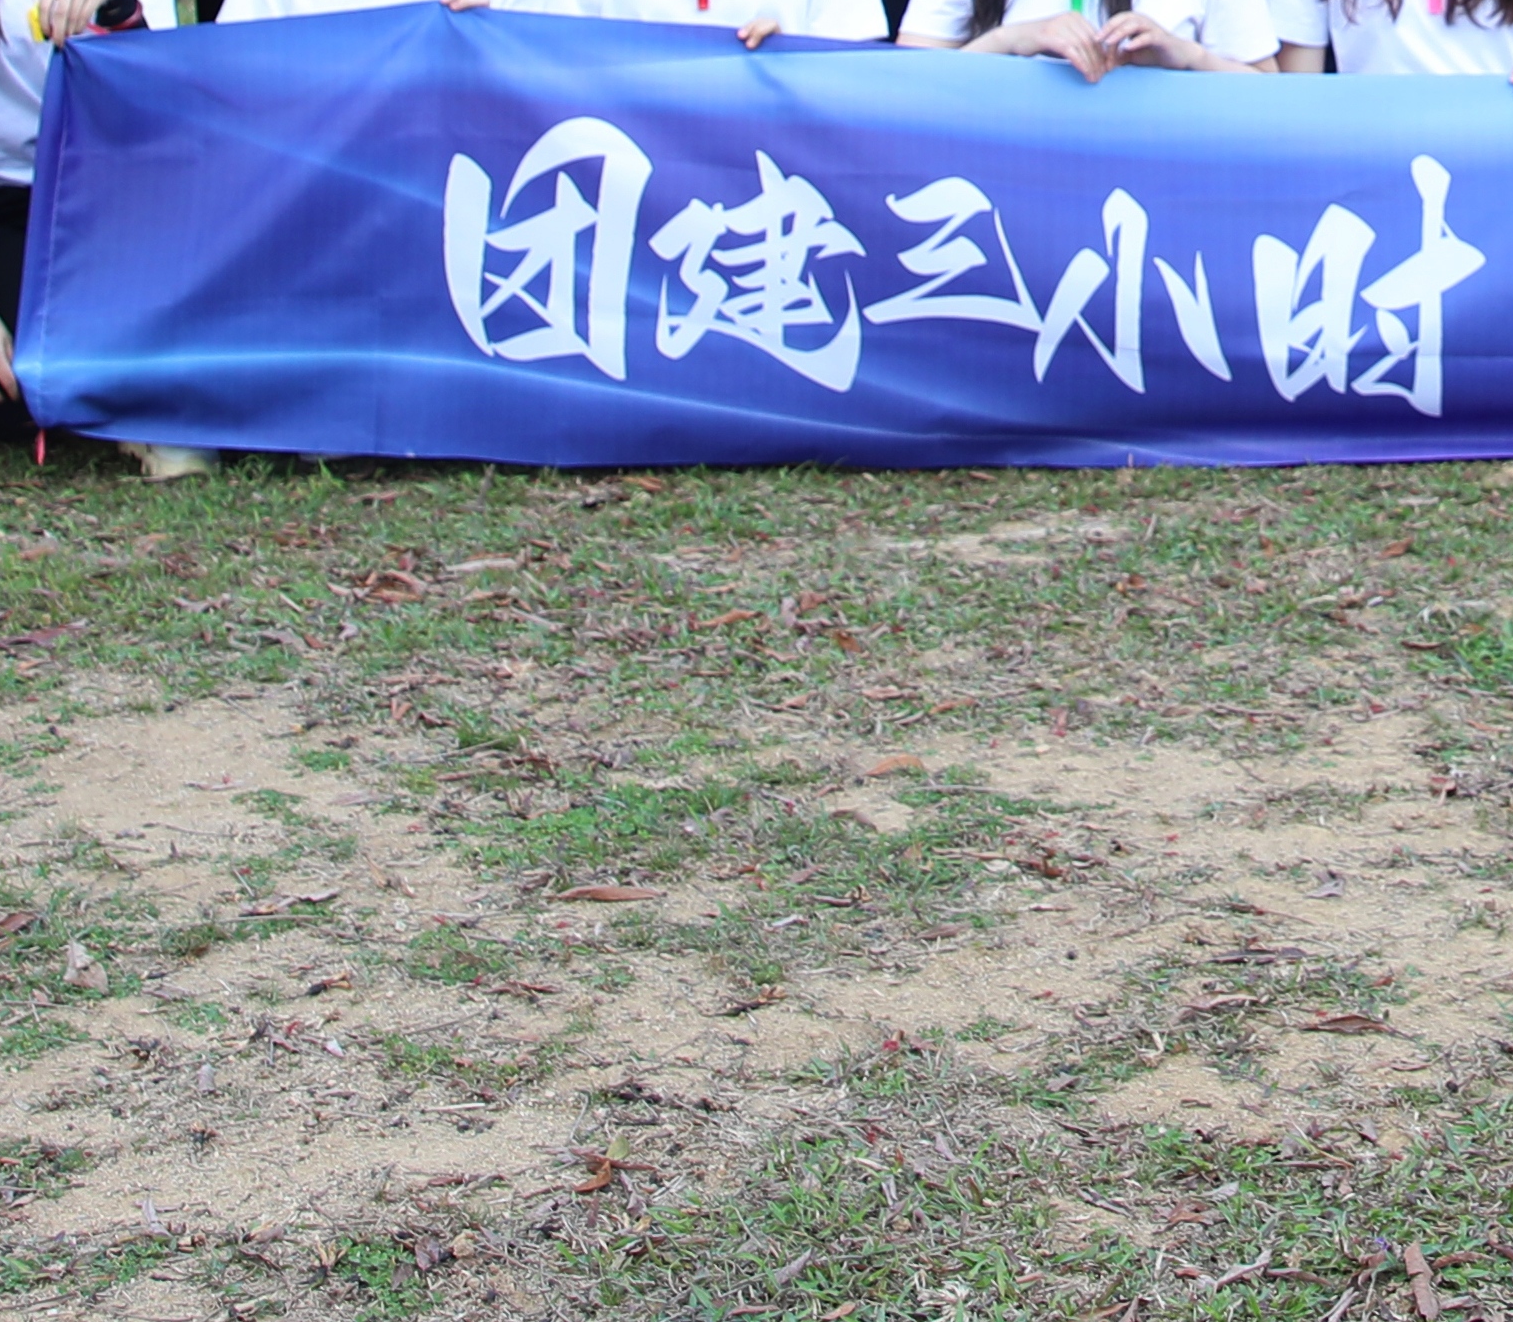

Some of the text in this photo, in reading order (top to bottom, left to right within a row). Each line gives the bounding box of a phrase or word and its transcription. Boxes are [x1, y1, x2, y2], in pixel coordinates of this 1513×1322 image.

[443, 115, 1488, 417] 团建三小时
